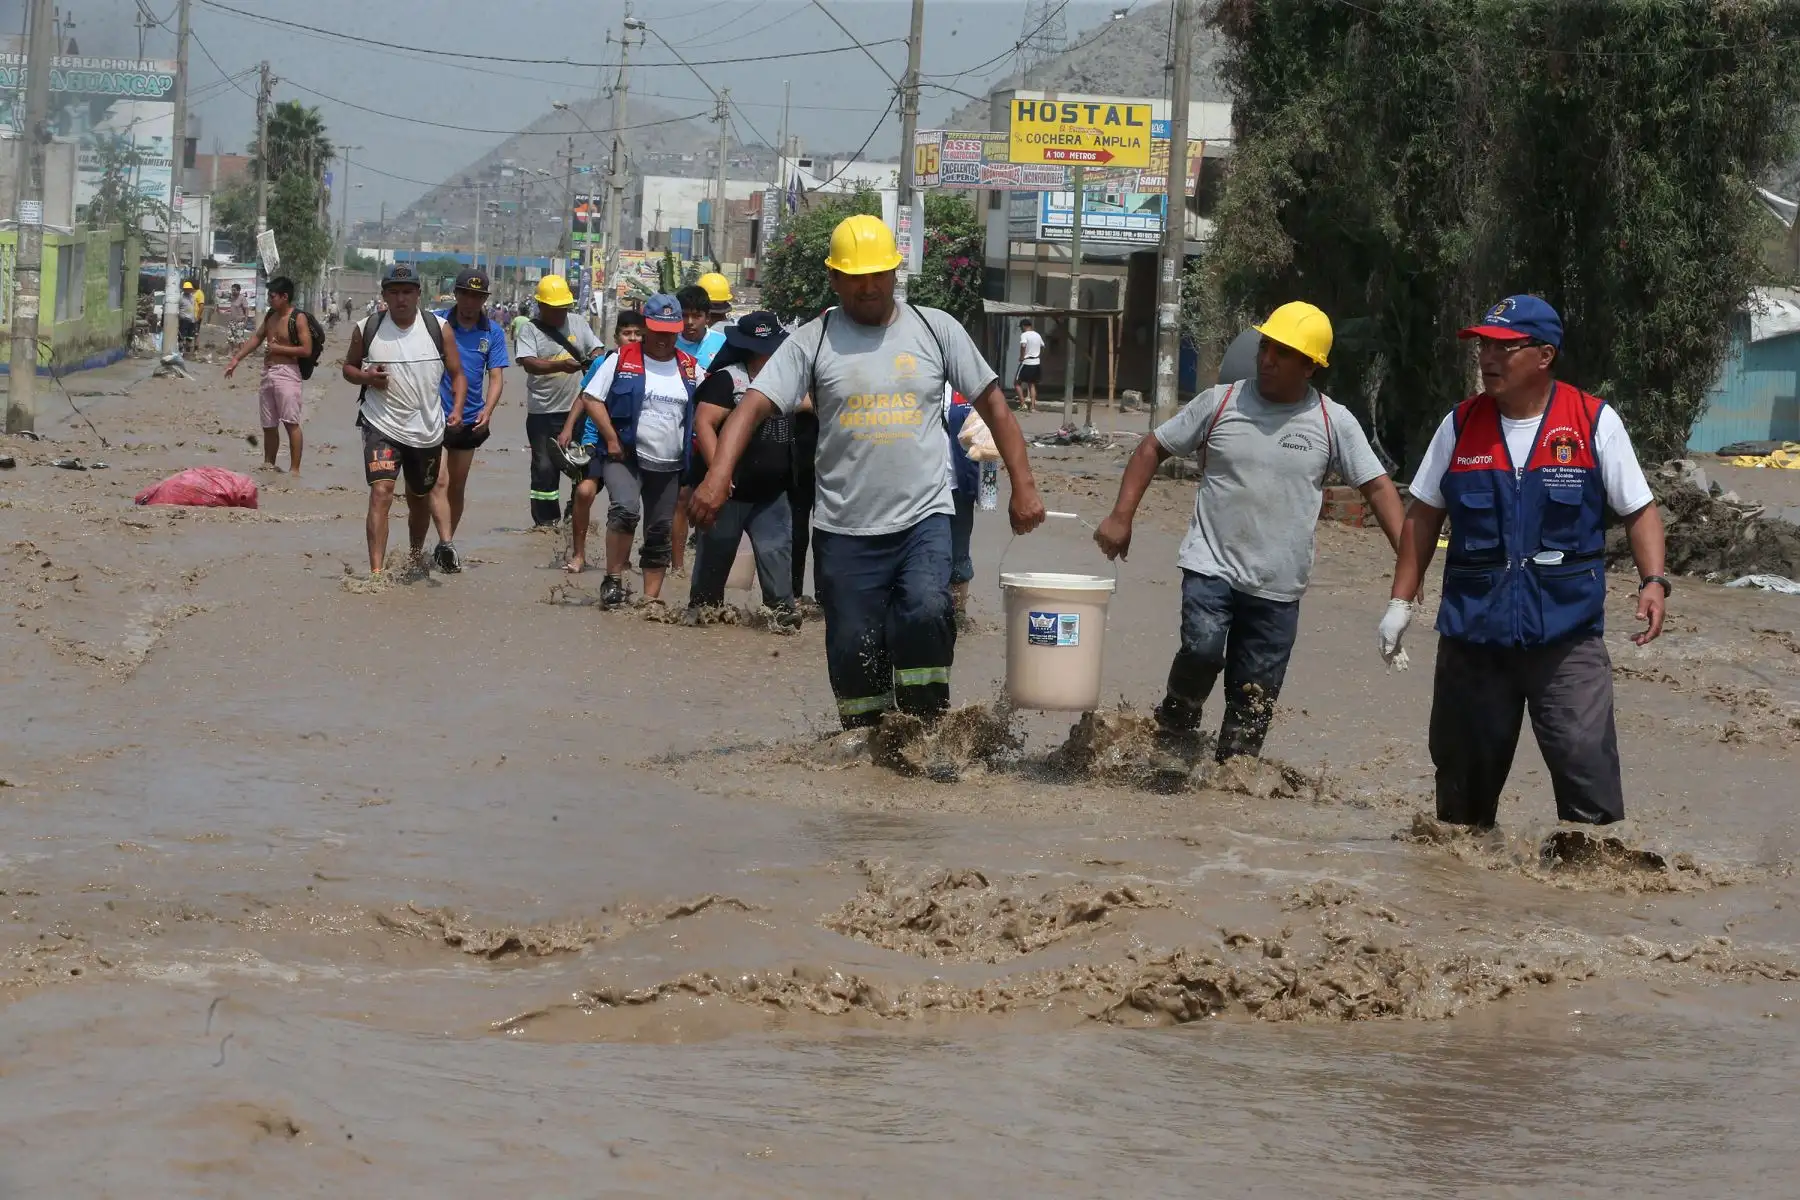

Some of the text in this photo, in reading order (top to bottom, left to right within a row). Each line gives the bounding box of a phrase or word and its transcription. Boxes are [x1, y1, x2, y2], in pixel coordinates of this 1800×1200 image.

[50, 56, 156, 72] ECREACIONAL
[1018, 101, 1143, 127] HOSTAL
[945, 140, 981, 151] ASES
[1026, 133, 1082, 146] COCHERA
[1093, 135, 1141, 148] AMPLIA
[915, 143, 940, 175] 05
[1046, 150, 1097, 161] A 100 METROS
[942, 162, 979, 179] EXCELENTES
[847, 392, 918, 410] OBRAS
[839, 410, 924, 428] MENORES
[1457, 455, 1494, 465] PROMOTOR
